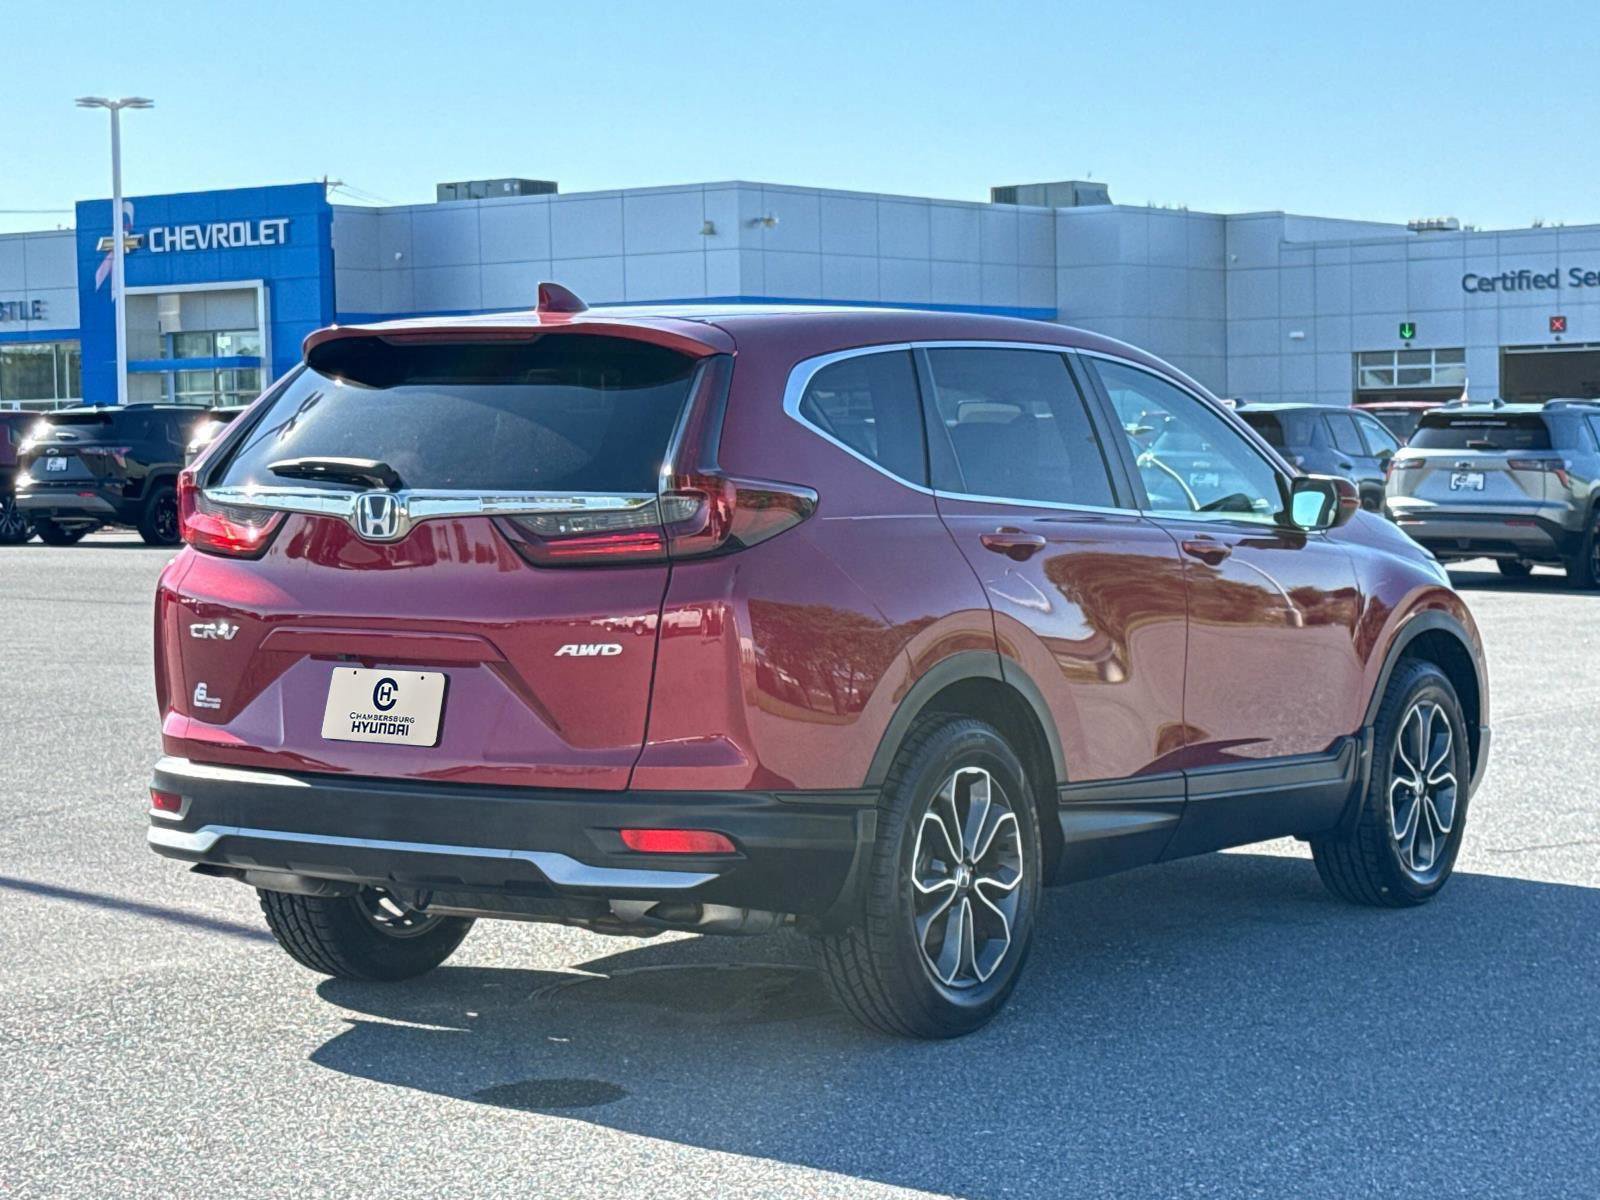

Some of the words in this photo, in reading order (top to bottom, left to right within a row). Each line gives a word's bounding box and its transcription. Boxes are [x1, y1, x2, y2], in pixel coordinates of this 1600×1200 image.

[149, 218, 290, 253] CHEVROLET
[1462, 268, 1559, 293] Certified
[554, 643, 623, 657] AWD
[350, 712, 415, 723] CHAMBERSBURG
[351, 721, 410, 736] HYUNDAI
